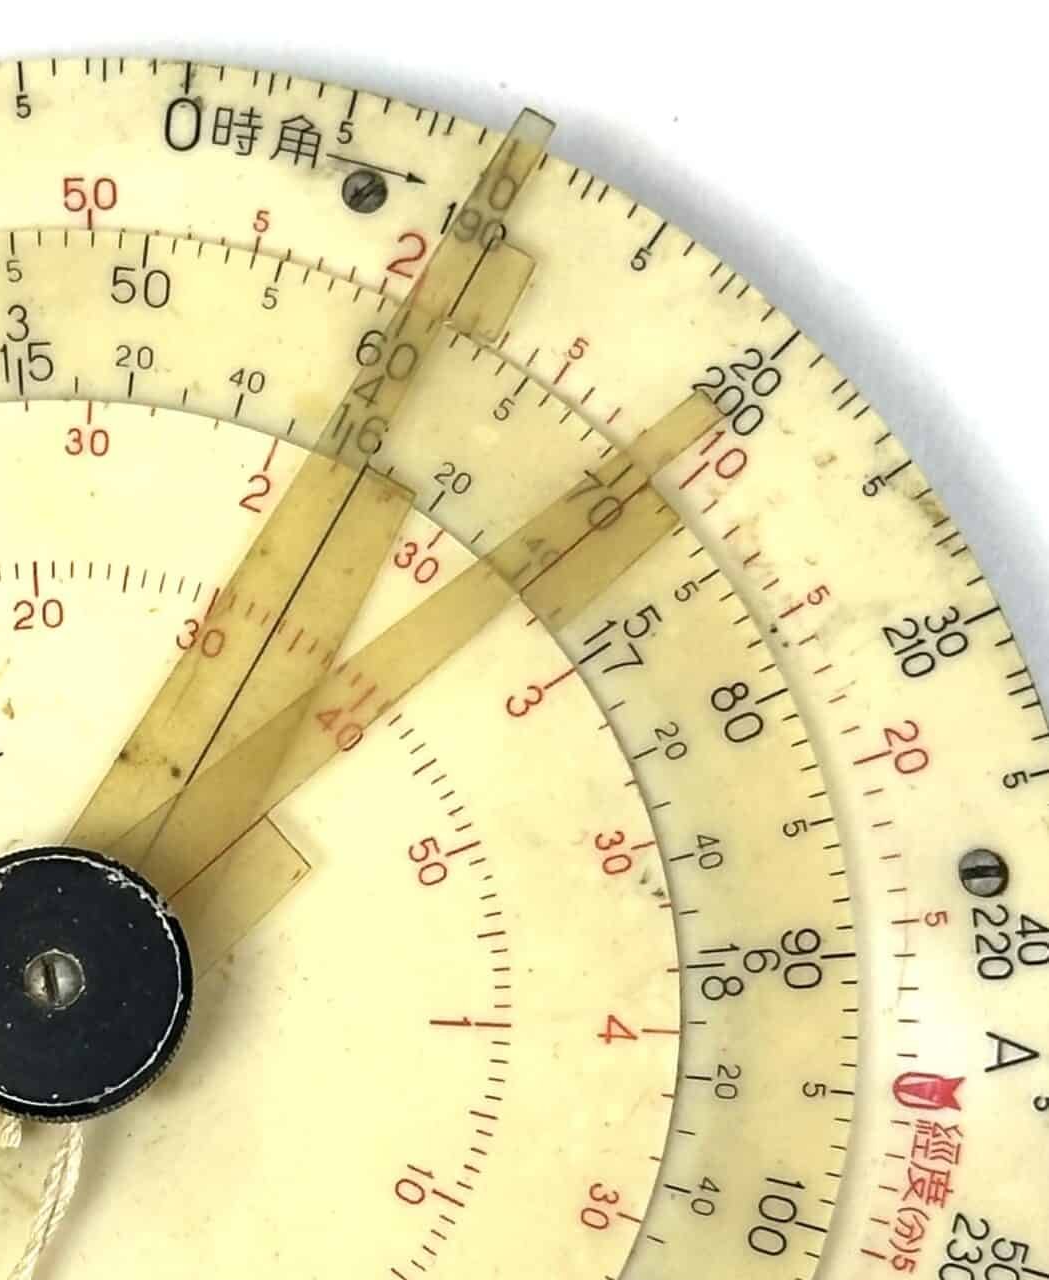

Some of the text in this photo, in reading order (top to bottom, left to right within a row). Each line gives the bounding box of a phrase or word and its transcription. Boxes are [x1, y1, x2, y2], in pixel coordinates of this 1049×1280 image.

[16, 94, 31, 119] 5
[164, 97, 201, 151] 0
[64, 178, 116, 212] 50
[253, 211, 270, 232] 5
[387, 233, 427, 278] 2
[111, 267, 171, 308] 50
[262, 287, 278, 309] 5
[7, 305, 28, 342] 3
[356, 330, 417, 381] 60
[730, 349, 781, 396] 20
[229, 369, 265, 394] 40
[692, 366, 764, 436] 200
[65, 429, 109, 456] 30
[700, 431, 747, 479] 10
[239, 475, 271, 513] 2
[13, 600, 64, 631] 20
[624, 605, 662, 638] 5
[925, 606, 968, 657] 30
[882, 618, 936, 678] 210
[506, 686, 544, 717] 3
[711, 683, 764, 743] 80
[884, 720, 928, 775] 20
[1003, 770, 1027, 789] 5
[783, 820, 807, 837] 5
[408, 837, 447, 886] 50
[697, 834, 723, 869] 40
[925, 911, 948, 926] 5
[743, 949, 780, 973] 6
[781, 929, 822, 990] 90
[972, 904, 1014, 980] 220
[597, 1015, 638, 1044] 4
[984, 1031, 1040, 1073] A
[395, 1163, 434, 1205] 10
[690, 1177, 720, 1216] 40
[748, 1177, 805, 1256] 100
